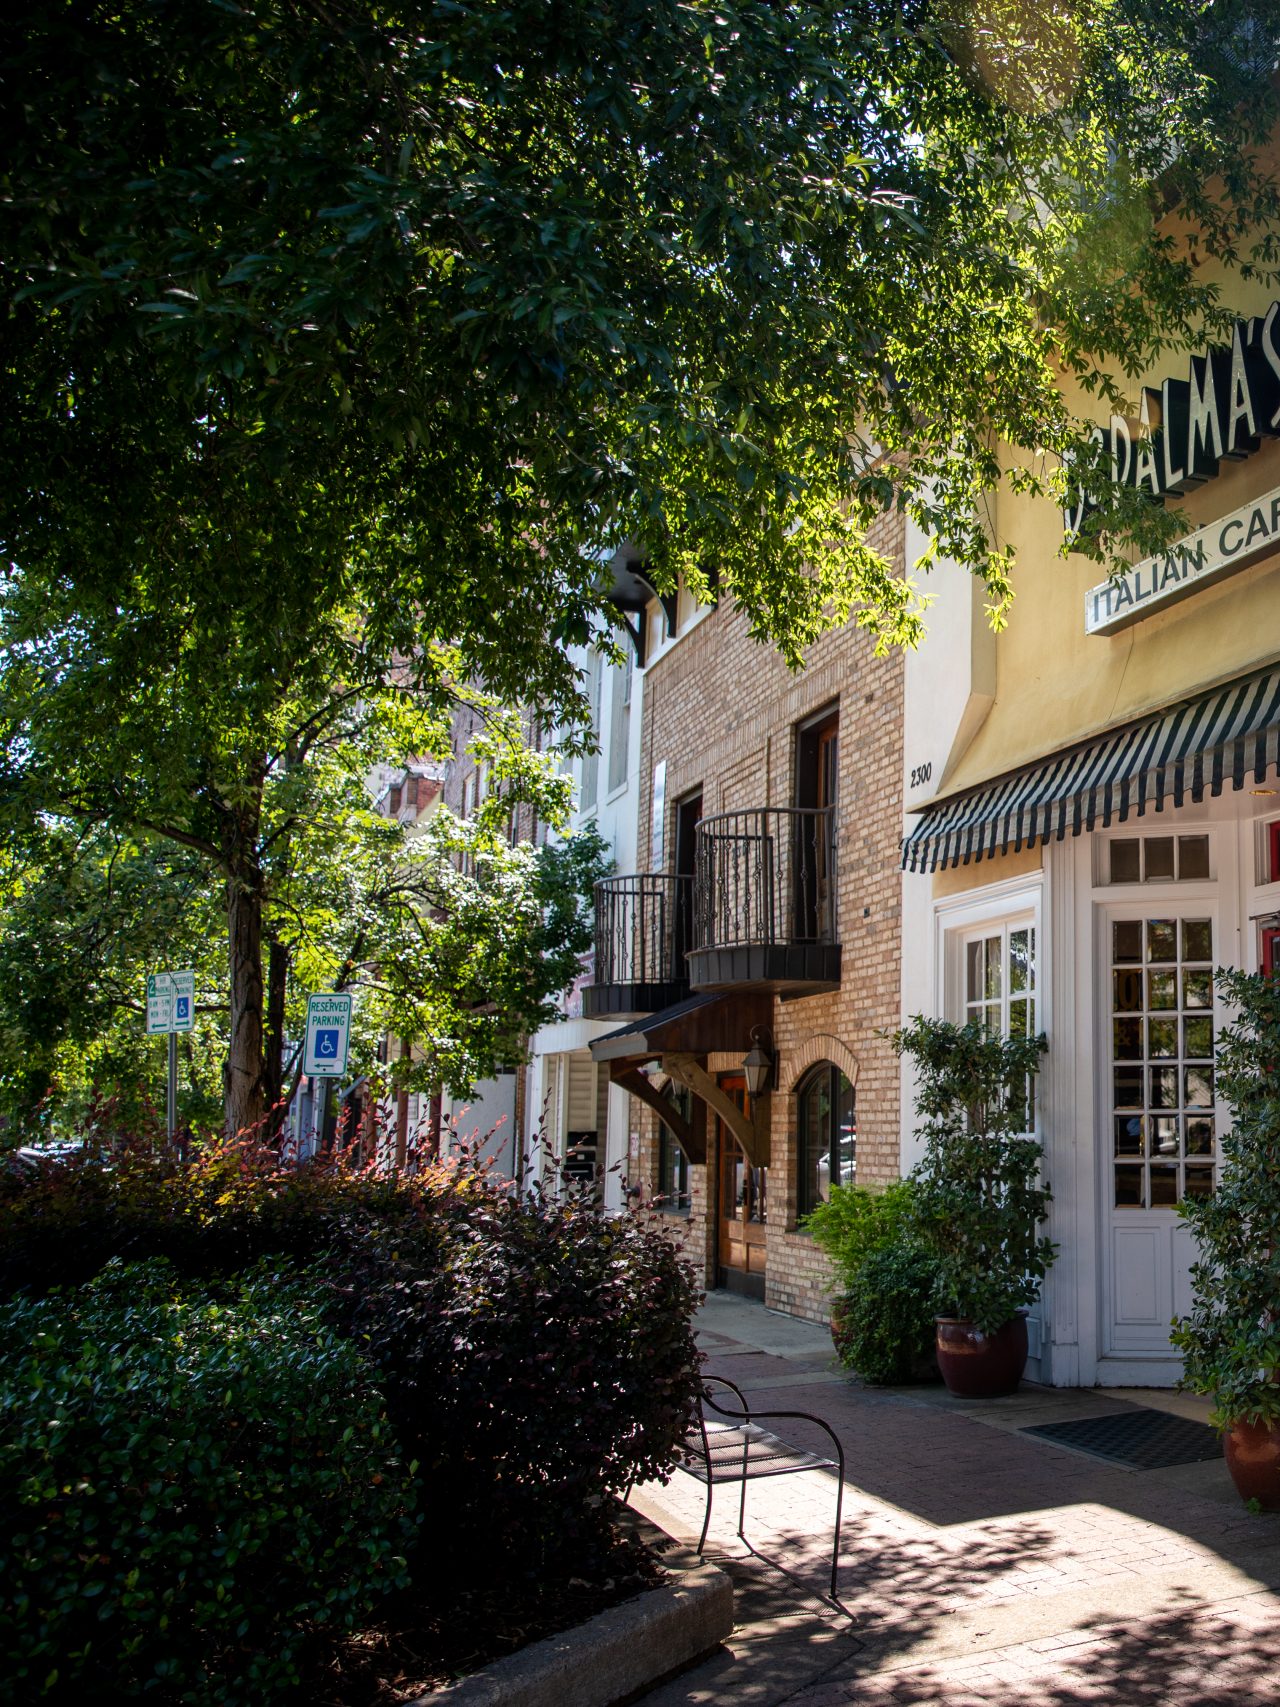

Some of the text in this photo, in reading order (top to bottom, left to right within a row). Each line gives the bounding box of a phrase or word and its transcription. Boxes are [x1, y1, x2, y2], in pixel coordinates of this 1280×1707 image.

[1093, 540, 1205, 624] ITALIAN
[910, 761, 932, 789] 2300
[149, 980, 155, 993] 2
[311, 1001, 349, 1012] RESERVED
[312, 1015, 345, 1026] PARKING
